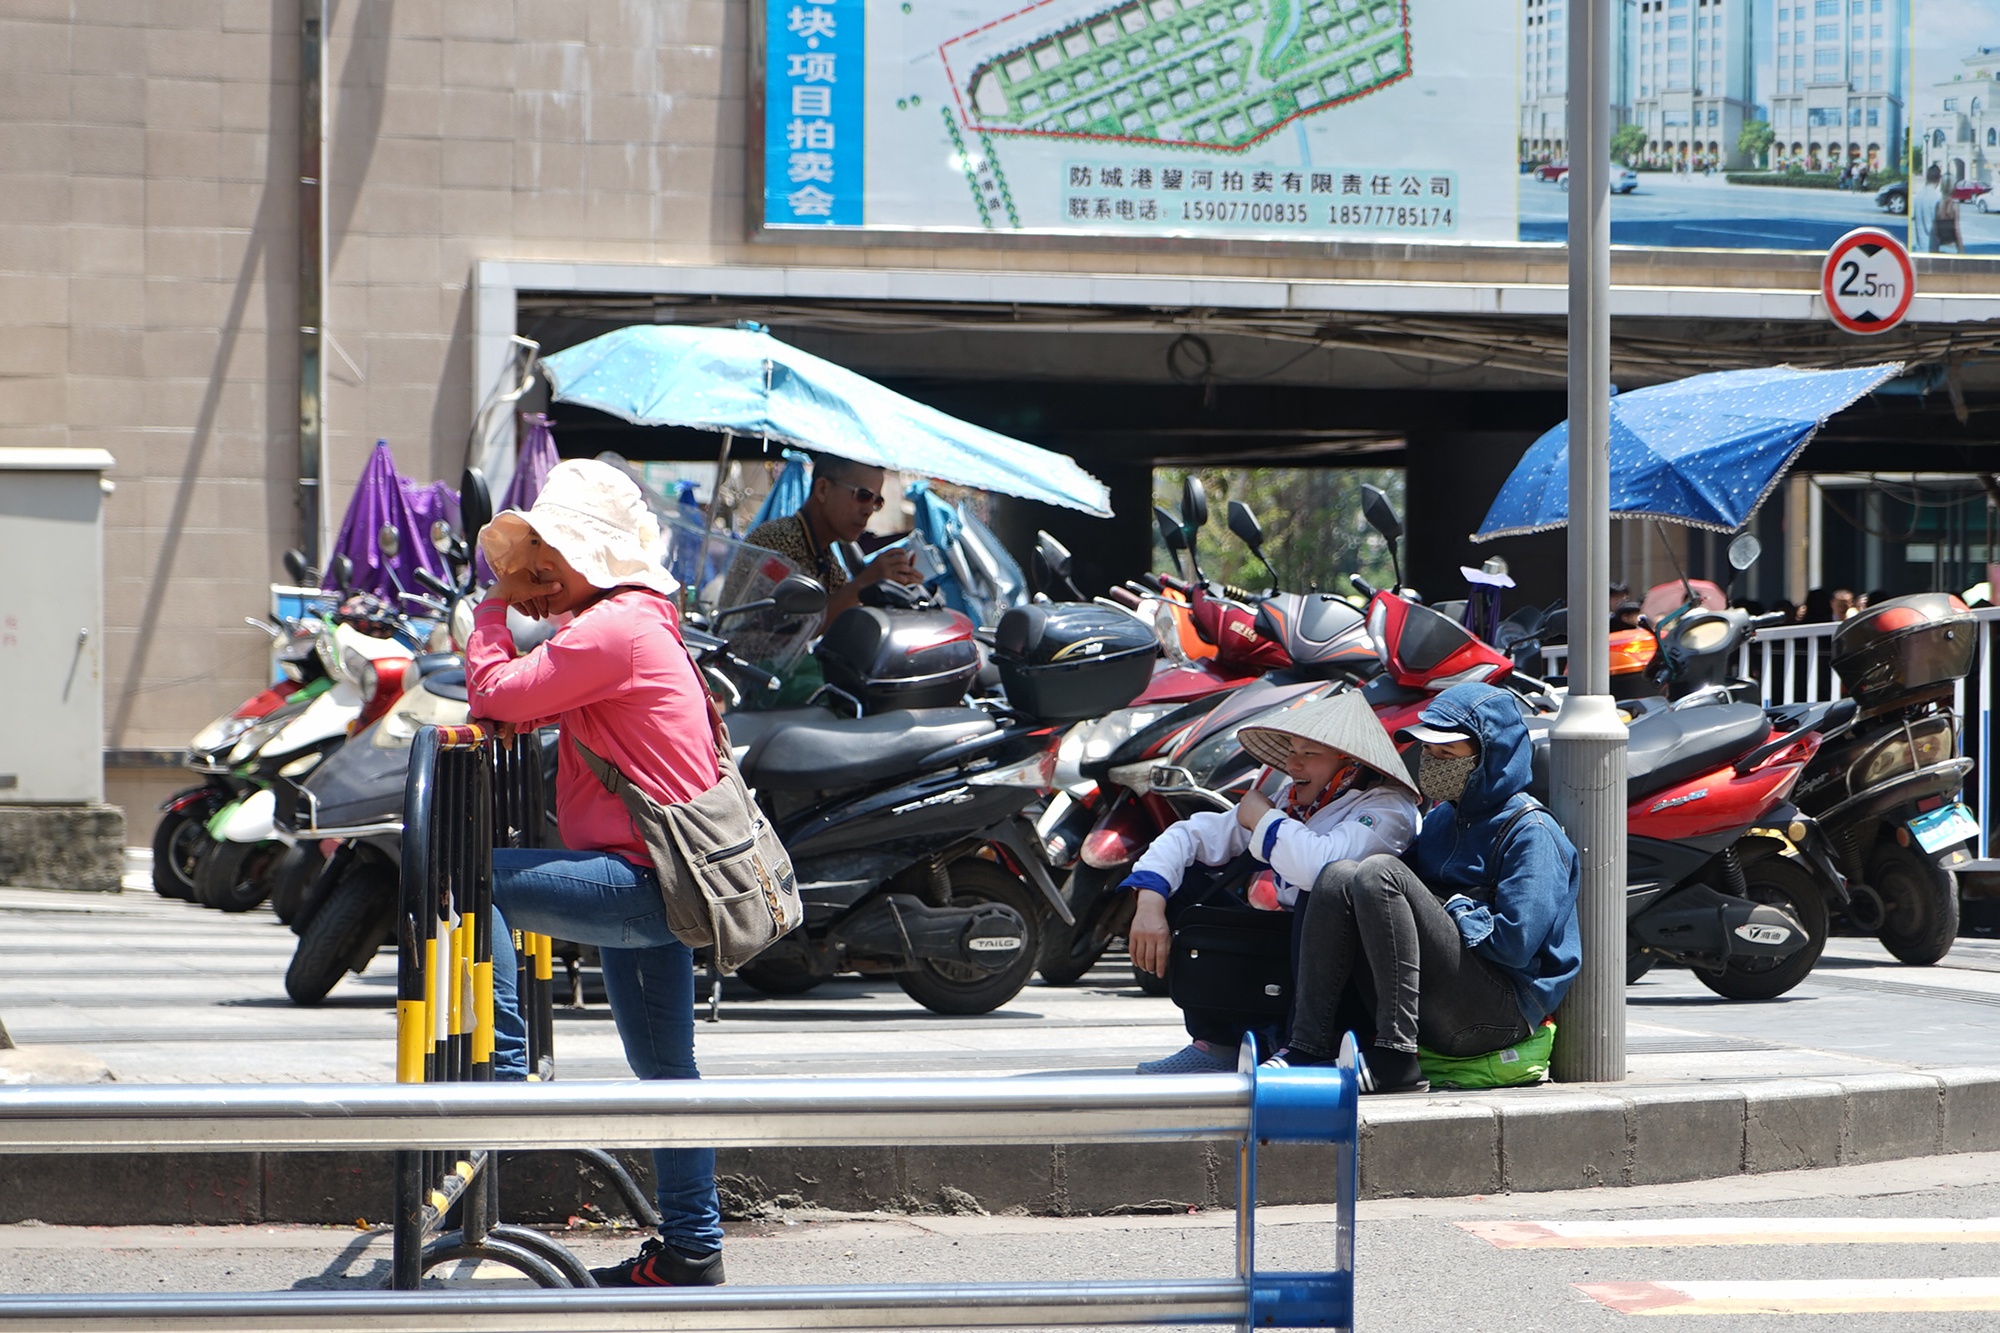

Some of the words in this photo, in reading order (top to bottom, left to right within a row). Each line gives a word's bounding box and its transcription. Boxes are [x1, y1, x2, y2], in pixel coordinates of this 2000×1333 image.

[787, 0, 837, 217] 块·项目拍卖会
[1181, 201, 1308, 223] 15907700835
[1328, 205, 1452, 227] 18577785174
[1839, 260, 1896, 298] 2.5m
[976, 939, 1014, 948] TAILG
